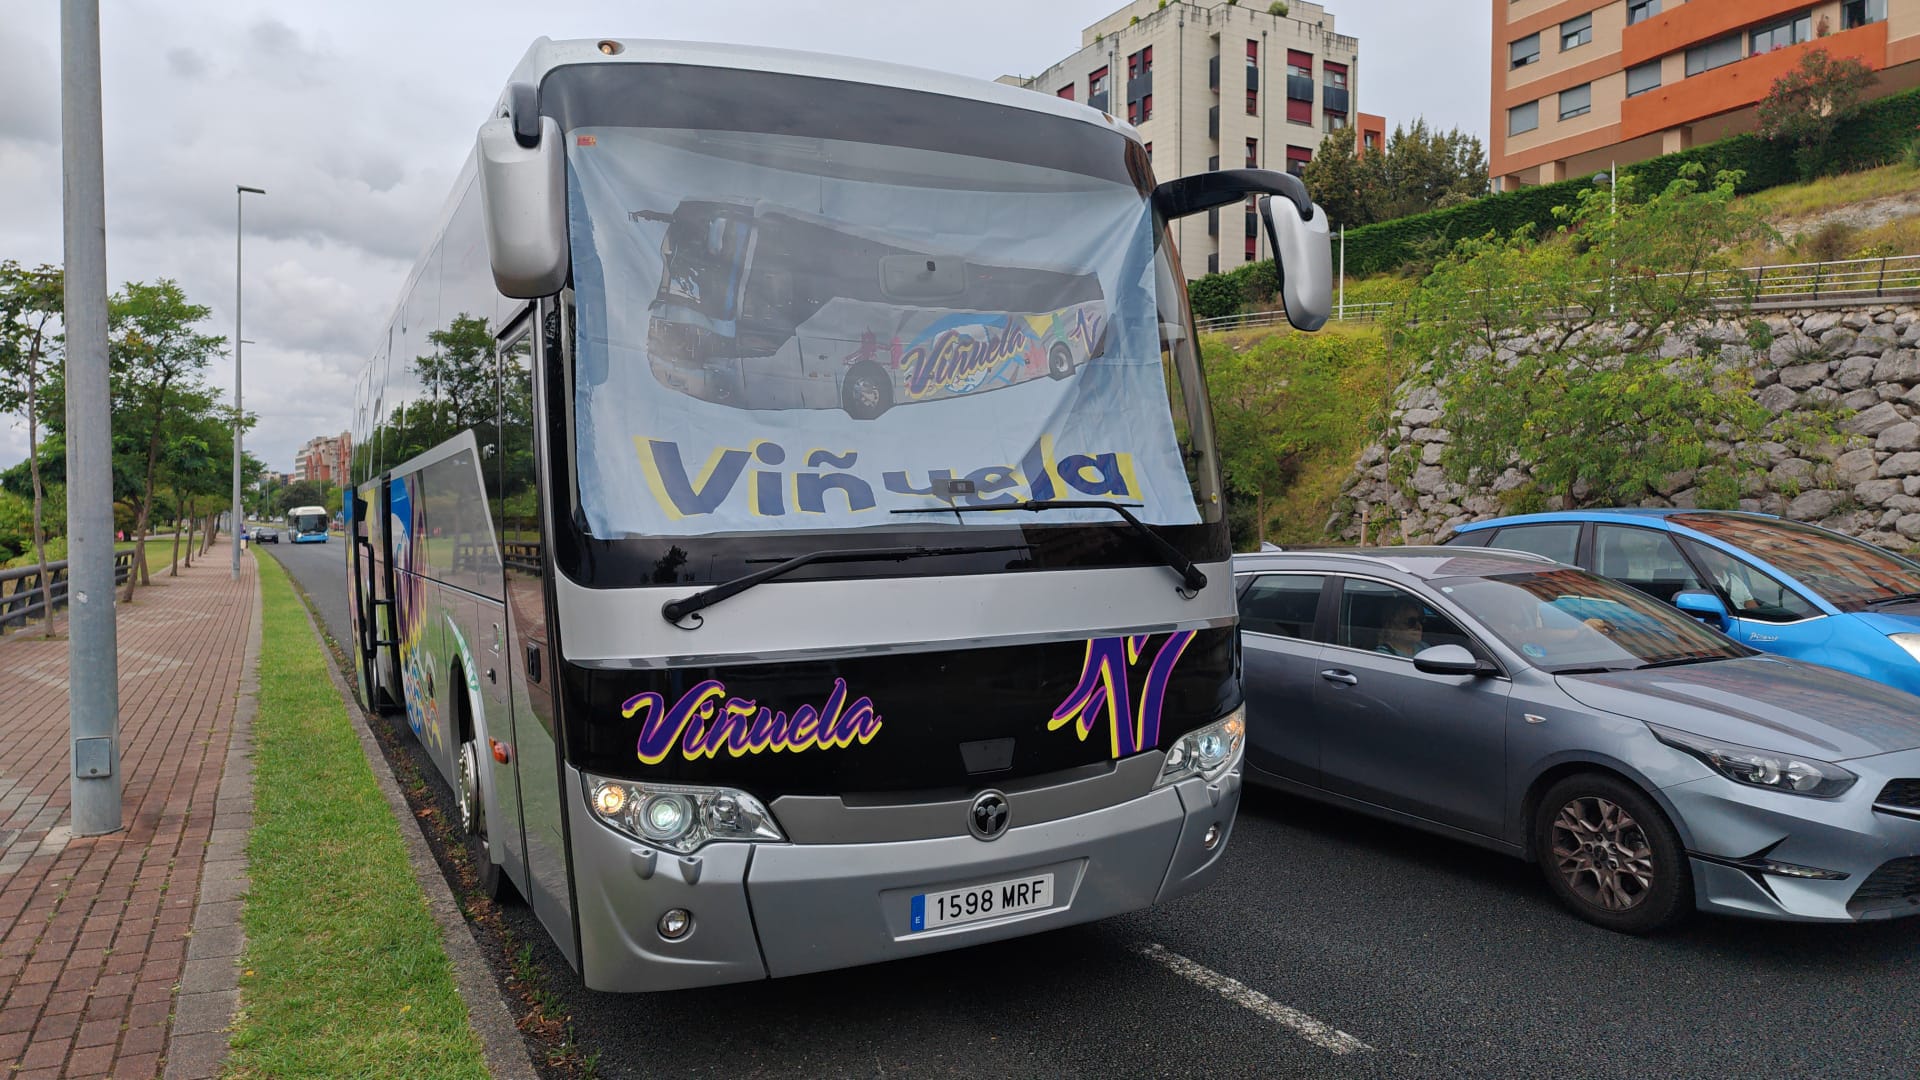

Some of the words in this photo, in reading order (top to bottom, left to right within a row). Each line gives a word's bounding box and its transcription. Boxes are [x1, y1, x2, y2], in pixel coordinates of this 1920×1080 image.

[901, 316, 1026, 398] Viñuela
[633, 433, 1145, 521] Viñuela
[622, 677, 882, 765] Viñuela
[937, 889, 993, 920] 1598
[1002, 880, 1045, 909] MRF
